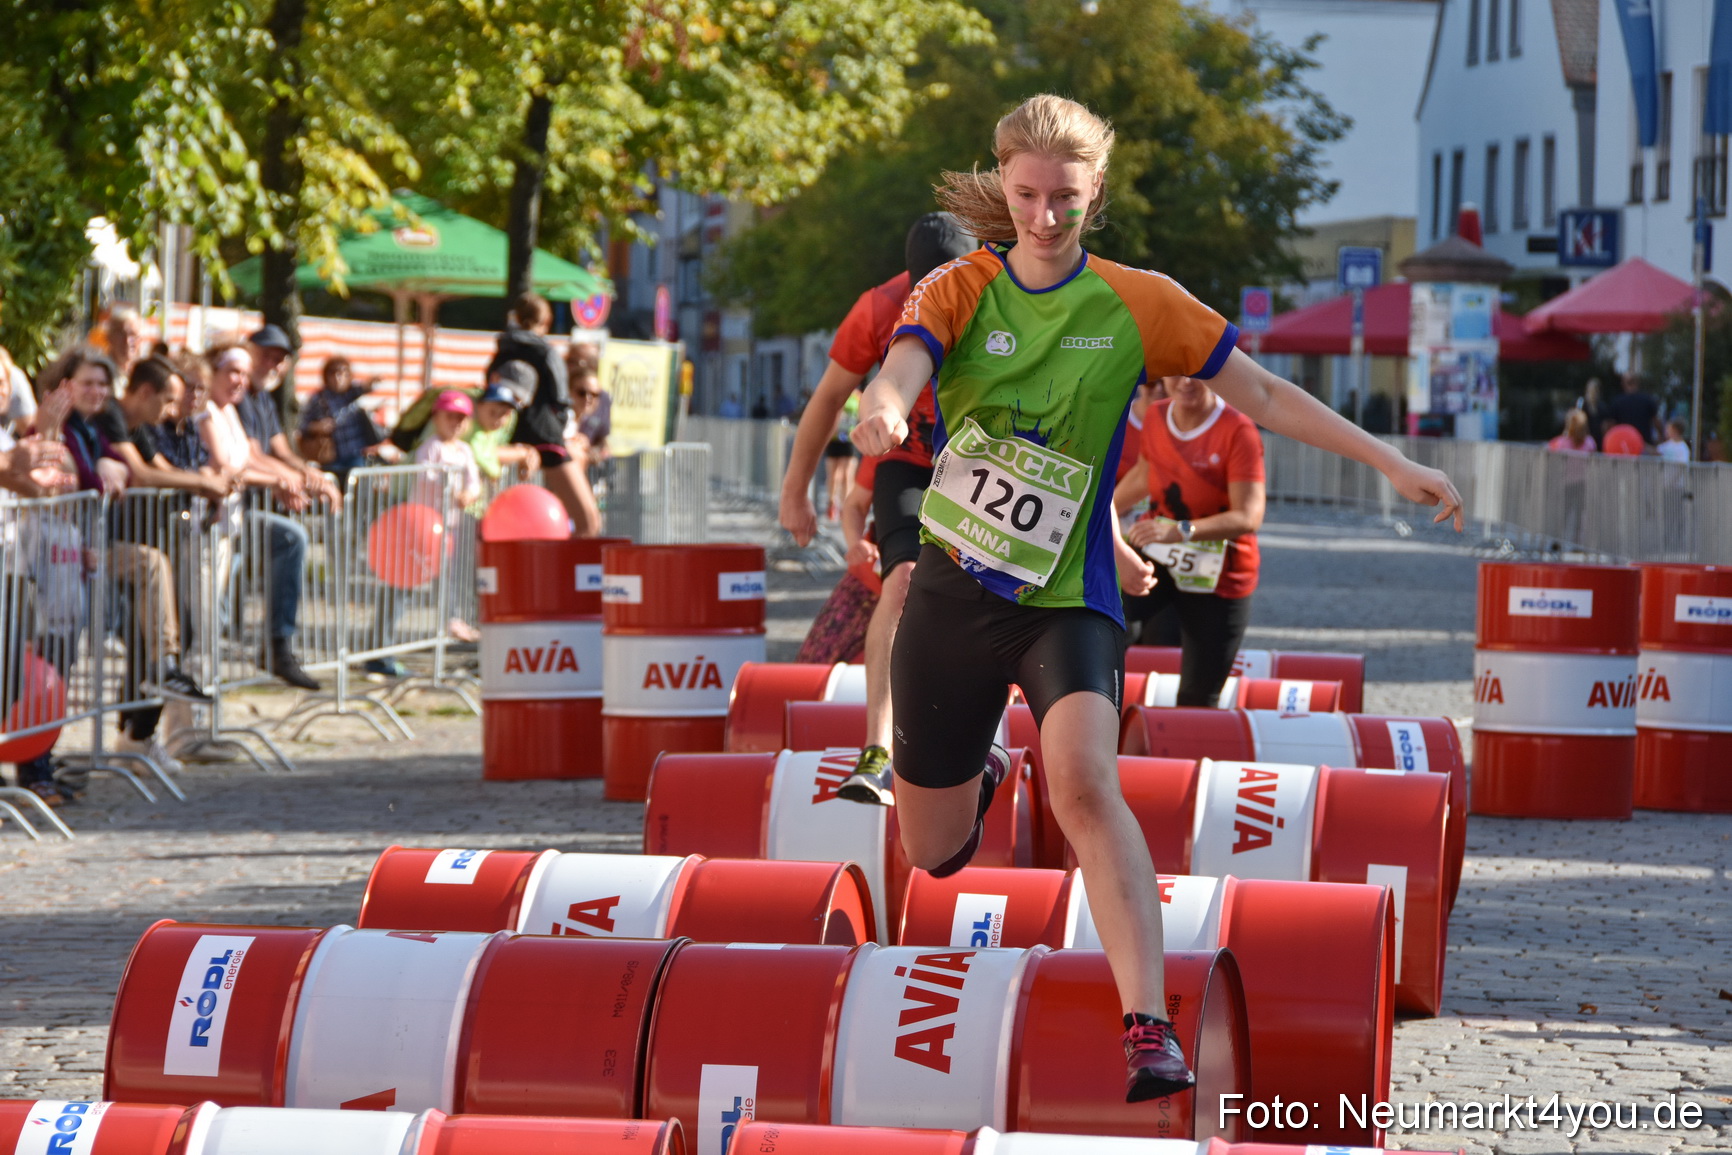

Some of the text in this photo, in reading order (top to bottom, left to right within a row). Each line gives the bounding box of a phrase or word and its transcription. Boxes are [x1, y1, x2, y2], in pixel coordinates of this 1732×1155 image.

[1061, 337, 1114, 349] BOCK
[957, 429, 1079, 494] BOCK
[969, 468, 1043, 532] 120
[1060, 509, 1072, 519] E6
[956, 517, 1011, 557] ANNA
[1168, 549, 1196, 572] 55
[990, 913, 1003, 947] nergie
[223, 950, 245, 990] energie
